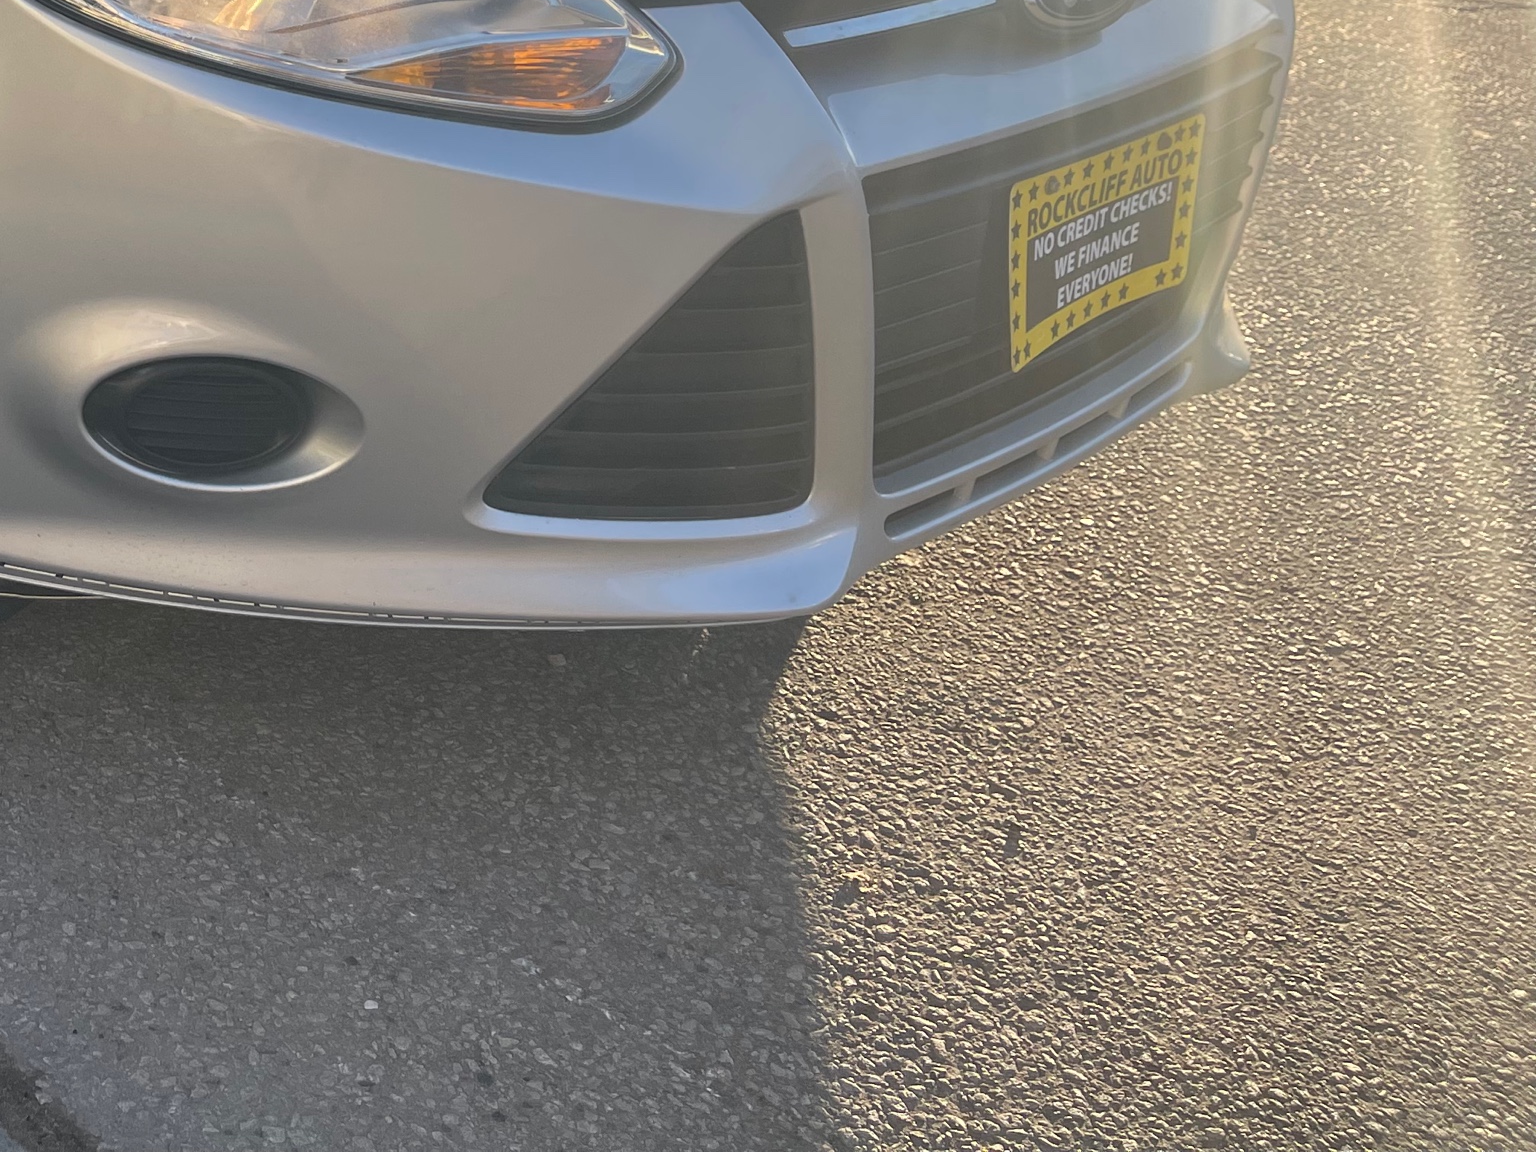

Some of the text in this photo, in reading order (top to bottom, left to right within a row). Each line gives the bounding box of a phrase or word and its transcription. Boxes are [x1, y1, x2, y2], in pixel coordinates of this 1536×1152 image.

[1027, 149, 1184, 238] ROCKCLIFF AUTO
[1034, 181, 1173, 261] NO CREDIT CHECKS!
[1054, 221, 1140, 280] WE FINANCE
[1056, 253, 1133, 309] EVERYONE!
